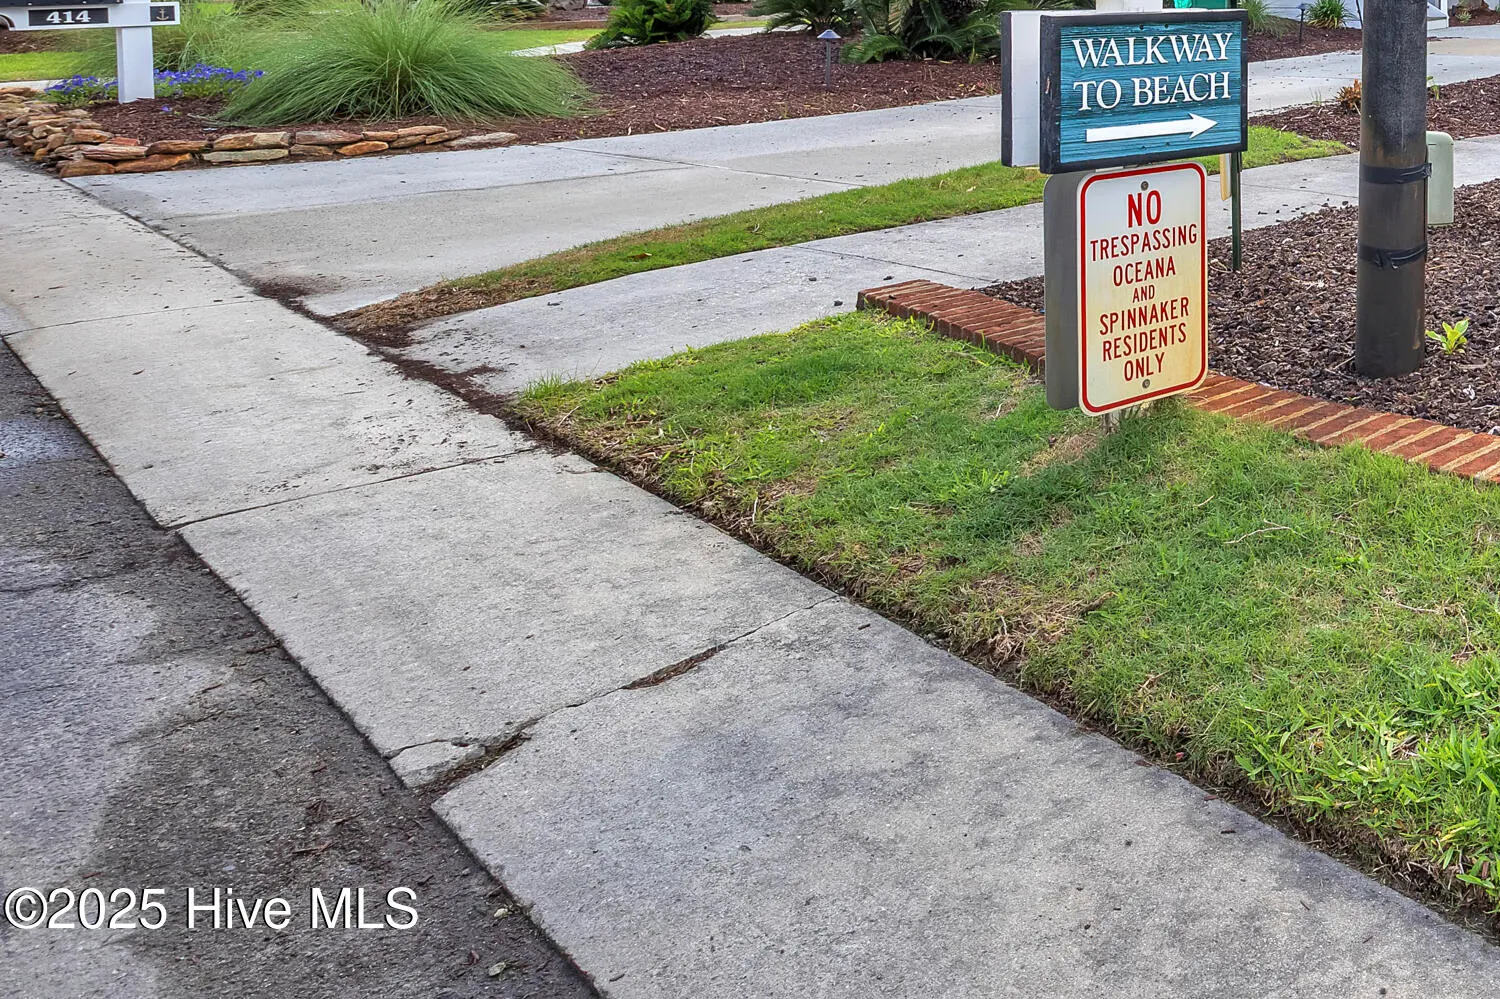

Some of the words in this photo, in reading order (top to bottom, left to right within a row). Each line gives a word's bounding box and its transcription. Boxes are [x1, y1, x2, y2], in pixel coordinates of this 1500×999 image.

[45, 10, 91, 24] 414
[1072, 32, 1233, 69] WALKWAY
[1073, 78, 1122, 111] TO
[1133, 71, 1231, 107] BEACH
[1127, 190, 1162, 228] NO
[1090, 224, 1198, 262] TRESPASSING
[1113, 255, 1176, 287] OCEANA
[1132, 284, 1156, 303] AND
[1099, 297, 1189, 336] SPINNAKER
[1102, 322, 1187, 362] RESIDENTS
[1123, 352, 1165, 382] ONLY
